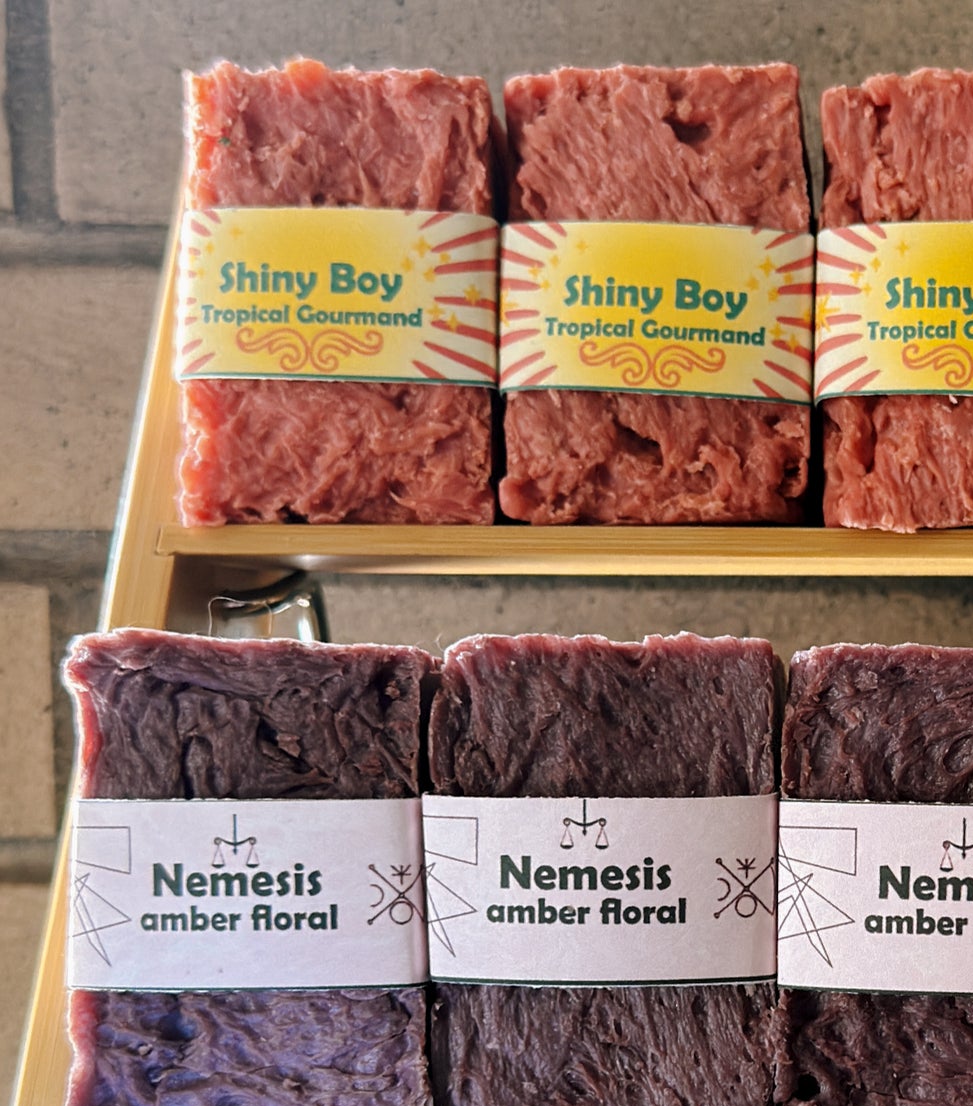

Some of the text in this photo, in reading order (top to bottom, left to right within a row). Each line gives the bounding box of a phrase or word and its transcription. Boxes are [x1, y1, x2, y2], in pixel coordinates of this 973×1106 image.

[220, 262, 403, 303] Shiny Boy
[564, 274, 749, 321] Shiny Boy
[201, 304, 423, 328] Tropical Gourmand
[545, 317, 767, 347] Tropical Gourmand
[867, 319, 957, 343] Tropical
[153, 862, 322, 898] Nemesis
[500, 854, 672, 891] Nemesis
[140, 903, 338, 932] amber floral
[486, 897, 687, 925] amber floral
[864, 908, 969, 936] amber
